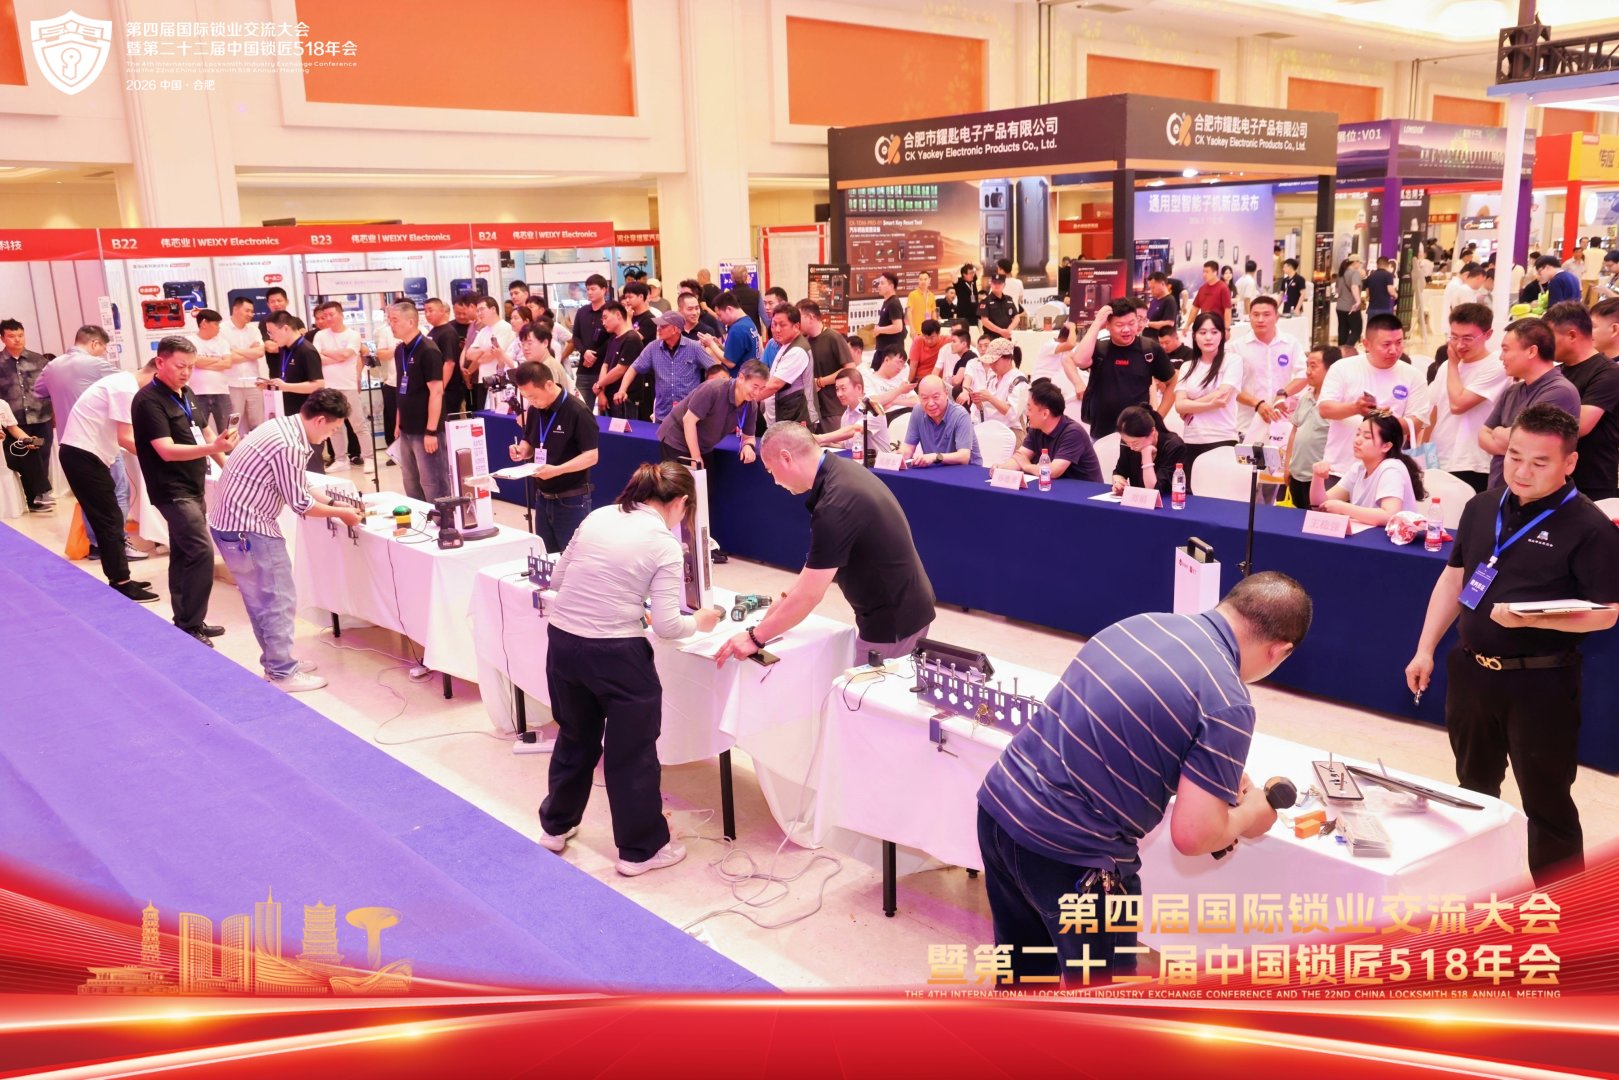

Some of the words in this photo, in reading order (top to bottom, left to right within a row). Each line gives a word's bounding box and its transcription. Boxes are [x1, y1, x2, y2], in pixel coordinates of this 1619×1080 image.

[904, 116, 1058, 149] 合肥市耀匙电子产品有限公司
[905, 151, 916, 161] CK
[918, 149, 944, 161] Yaokey
[946, 144, 983, 158] Electronic
[985, 141, 1020, 155] Products
[1022, 139, 1039, 152] Co.,
[1041, 137, 1058, 149] Ltd.
[1229, 137, 1258, 148] Electronic
[1259, 139, 1283, 150] Products
[1149, 194, 1260, 213] 通用型智能子机新品发布
[310, 235, 333, 246] B23
[382, 234, 407, 243] WEIXY
[409, 232, 451, 242] Electronics
[478, 231, 497, 241] B24
[538, 231, 561, 239] WEIXY
[562, 229, 598, 239] Electronics
[111, 238, 138, 250] B22
[197, 237, 228, 247] WEIXY
[230, 236, 280, 247] Electronics
